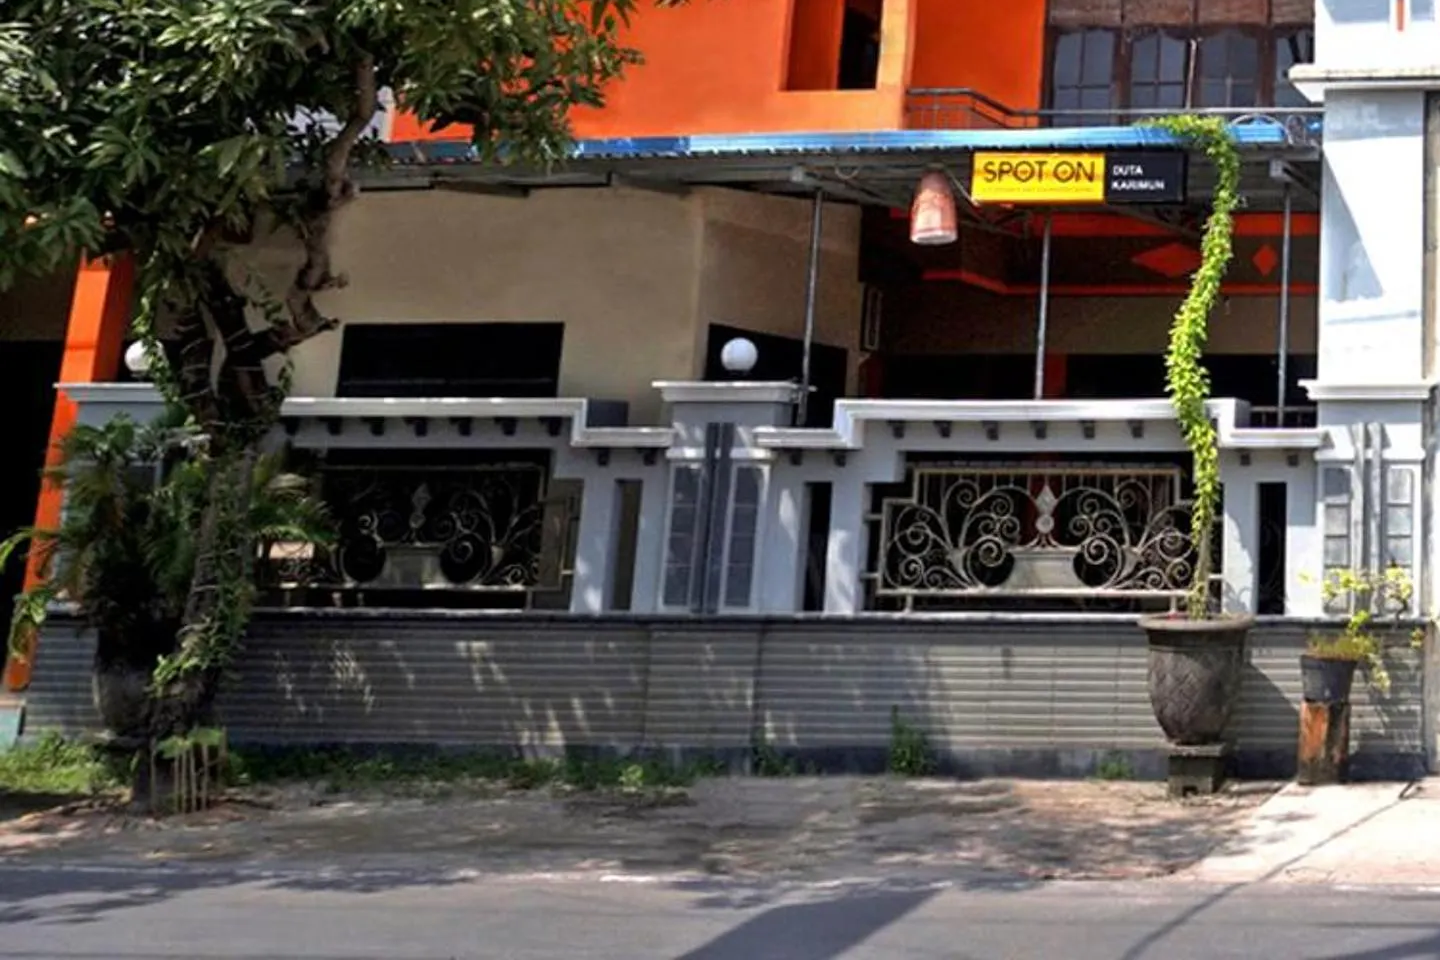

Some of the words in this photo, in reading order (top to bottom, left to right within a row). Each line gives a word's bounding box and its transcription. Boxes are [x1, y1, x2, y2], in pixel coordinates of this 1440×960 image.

[982, 160, 1047, 183] SPOT
[1053, 160, 1096, 183] ON
[1112, 164, 1143, 176] DUTA
[1111, 180, 1165, 191] KARIMUN
